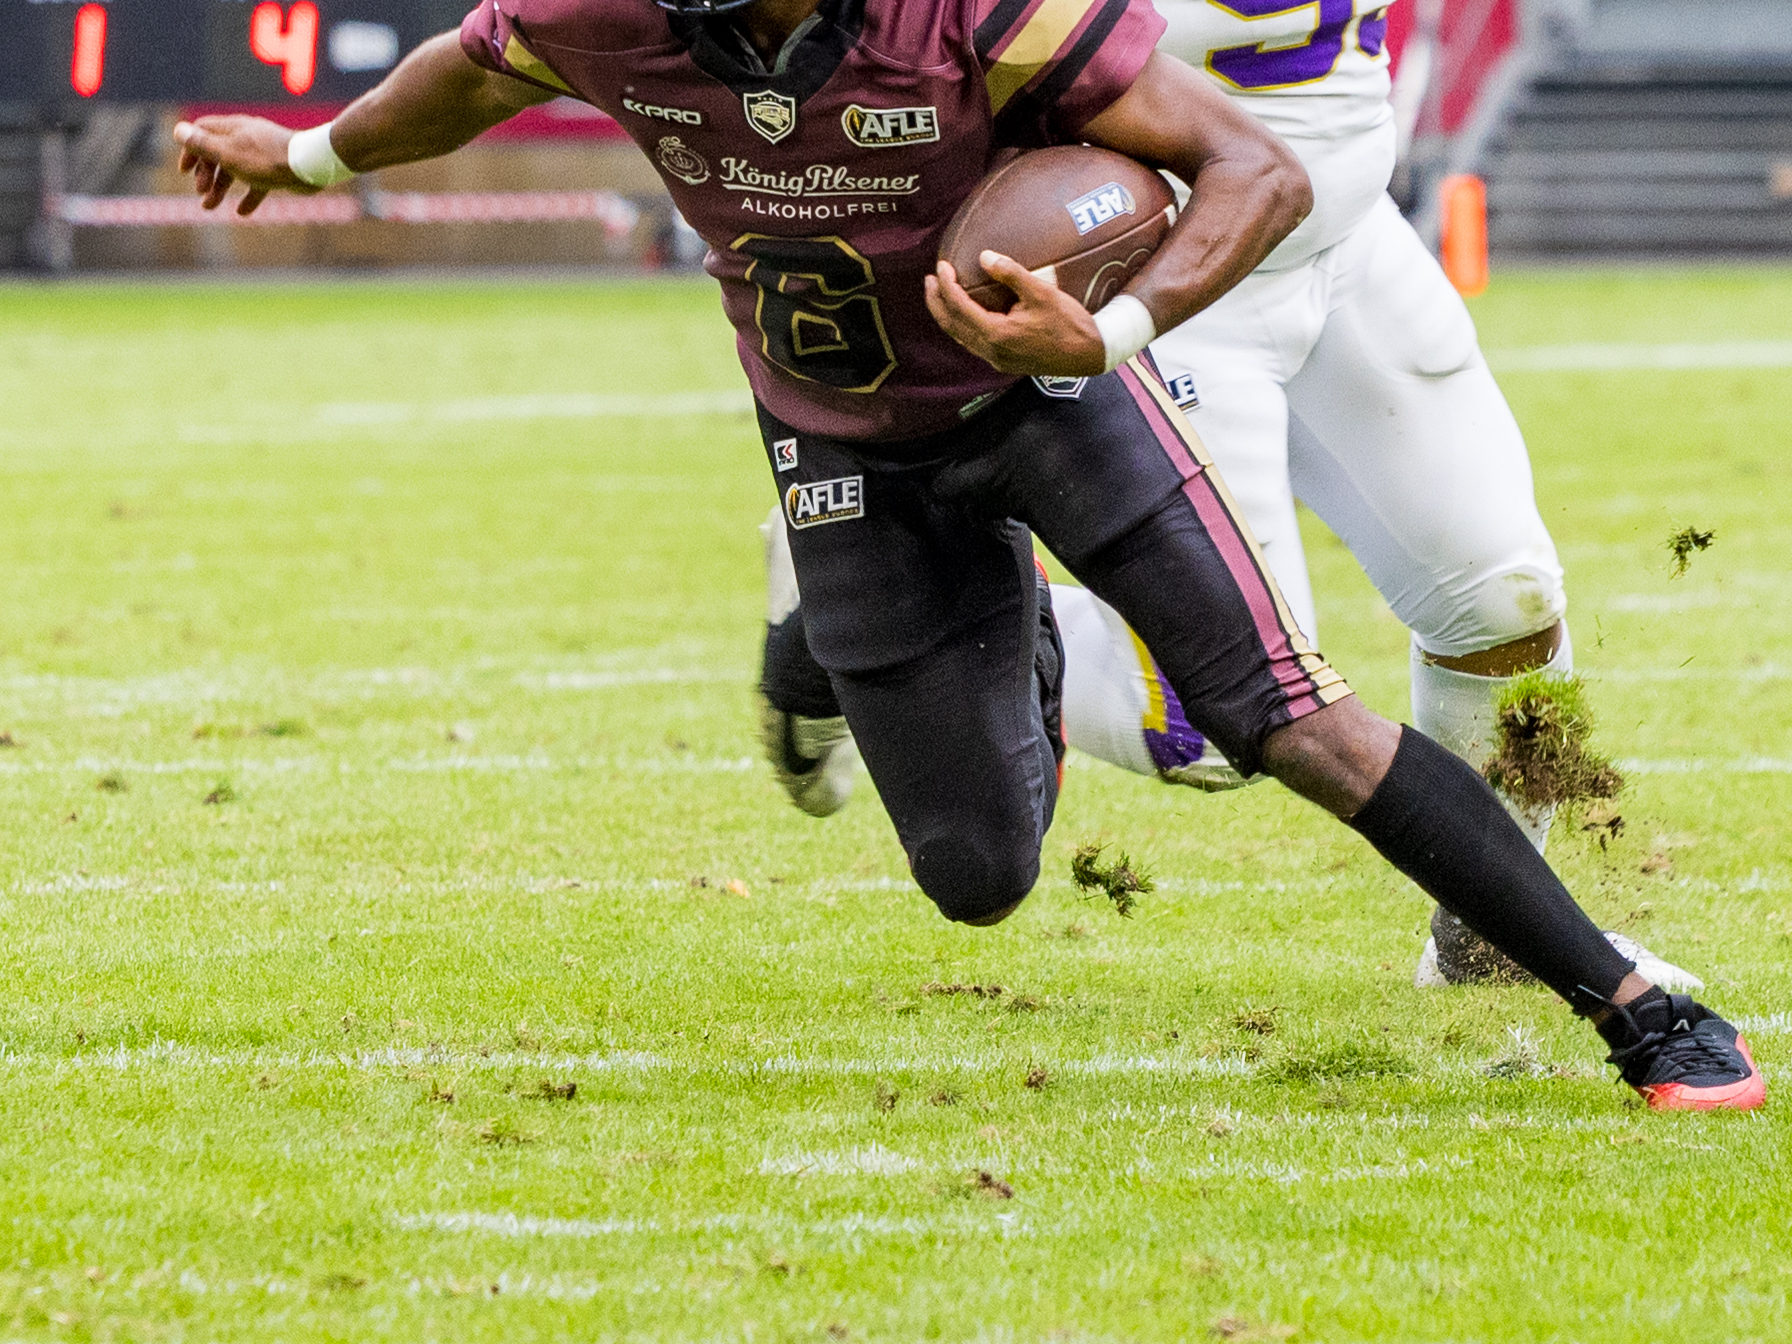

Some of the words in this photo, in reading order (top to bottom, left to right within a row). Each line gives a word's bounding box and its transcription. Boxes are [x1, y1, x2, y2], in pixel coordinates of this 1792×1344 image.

[72, 3, 107, 98] 1
[250, 0, 320, 95] 4
[860, 112, 933, 138] AFLE
[719, 157, 802, 196] König
[804, 164, 919, 192] Pilsener
[741, 197, 898, 220] ALKOHOLFREI
[1072, 187, 1125, 232] AFLE
[731, 231, 899, 393] 6
[796, 481, 858, 519] AFLE
